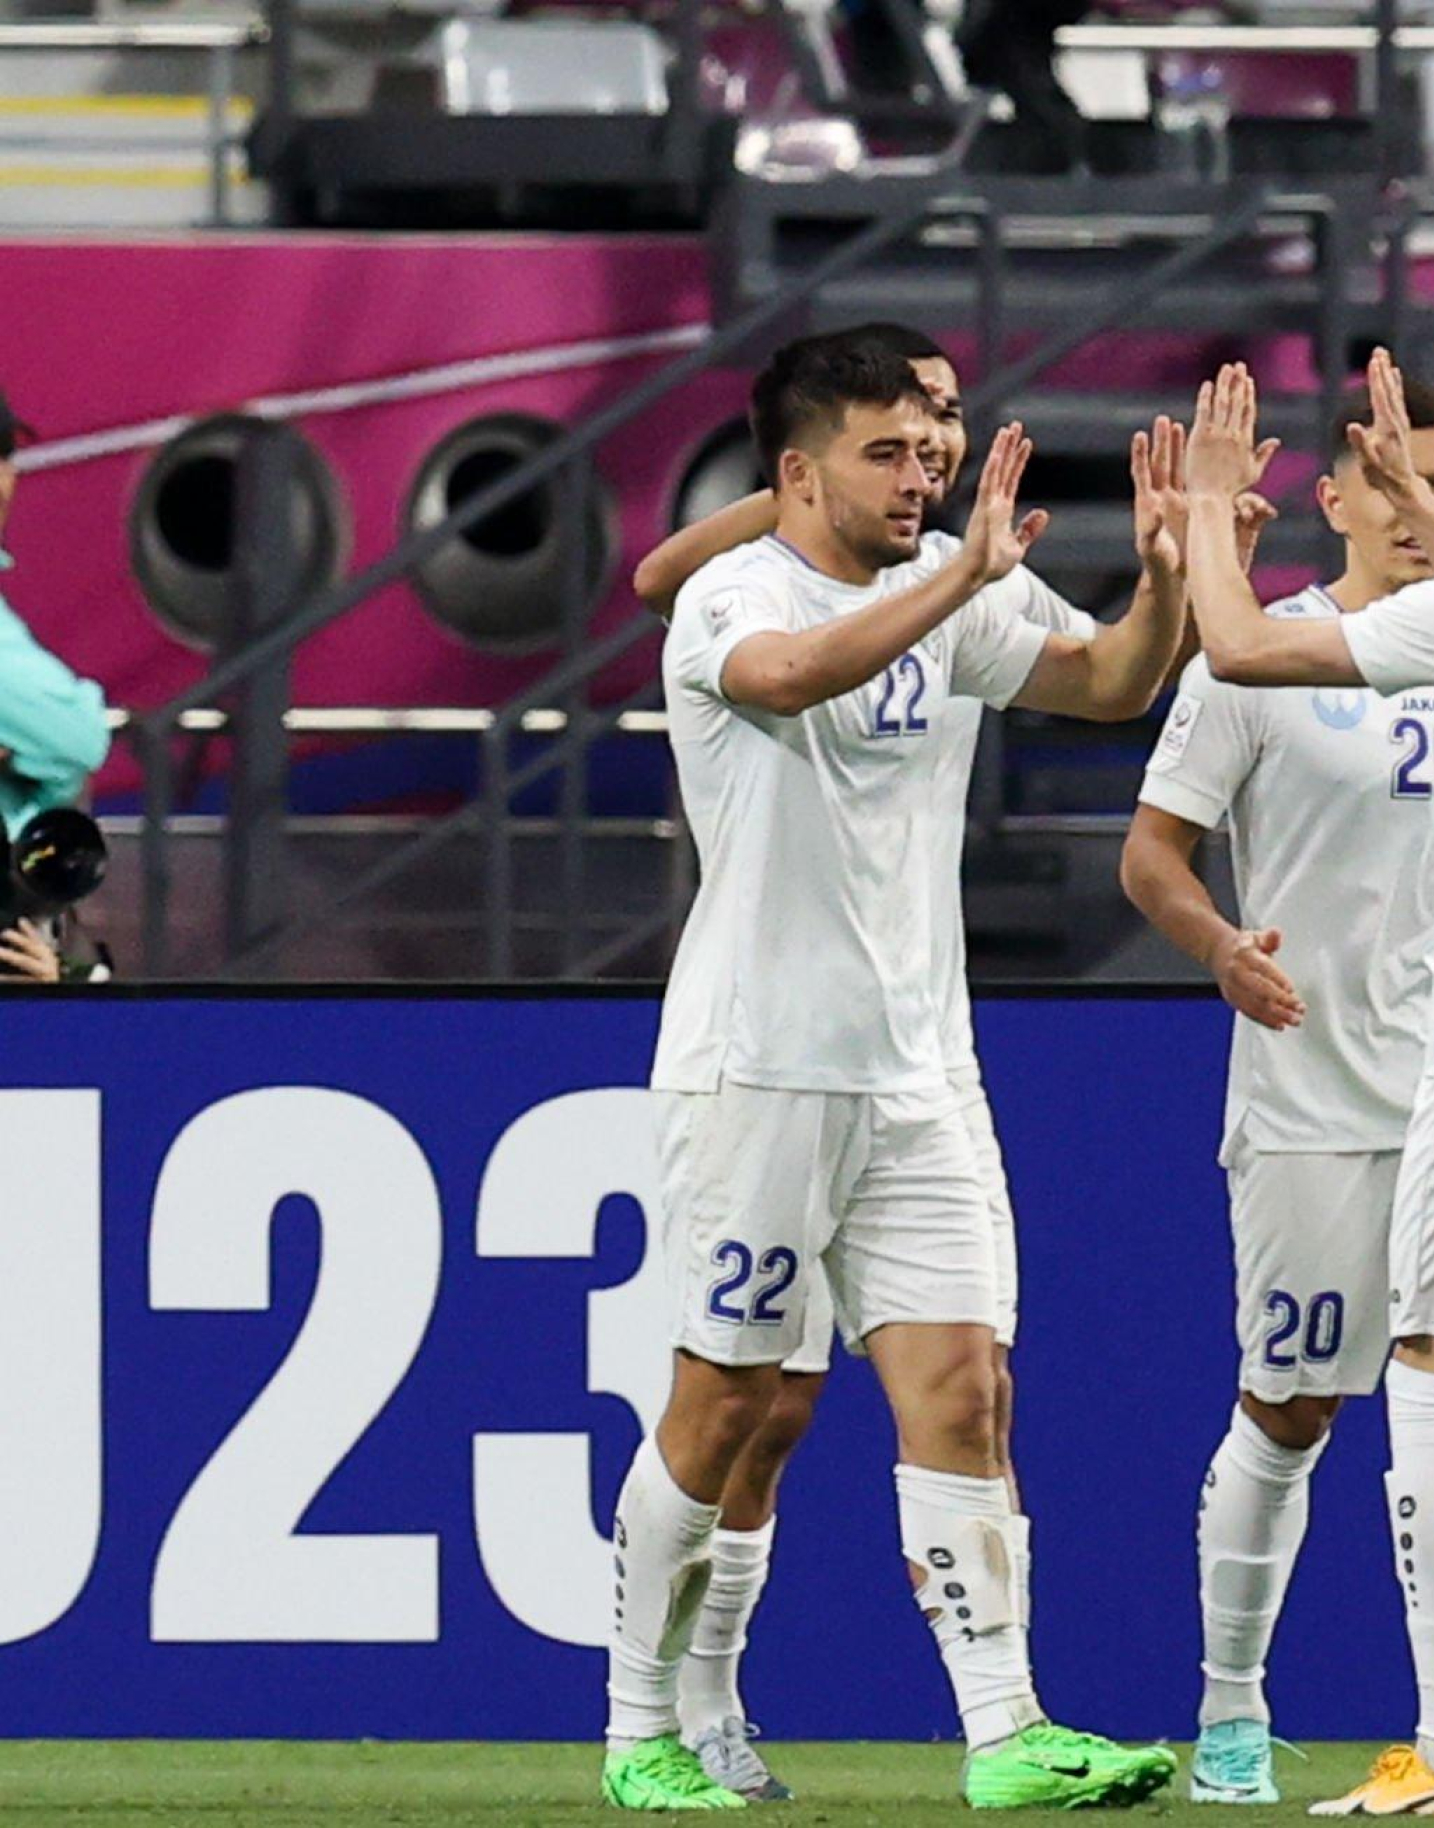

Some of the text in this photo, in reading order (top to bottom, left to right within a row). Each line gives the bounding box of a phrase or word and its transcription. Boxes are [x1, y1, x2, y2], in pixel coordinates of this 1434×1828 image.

[873, 651, 928, 736] 22
[709, 1239, 798, 1327] 22
[1262, 1289, 1346, 1373] 20
